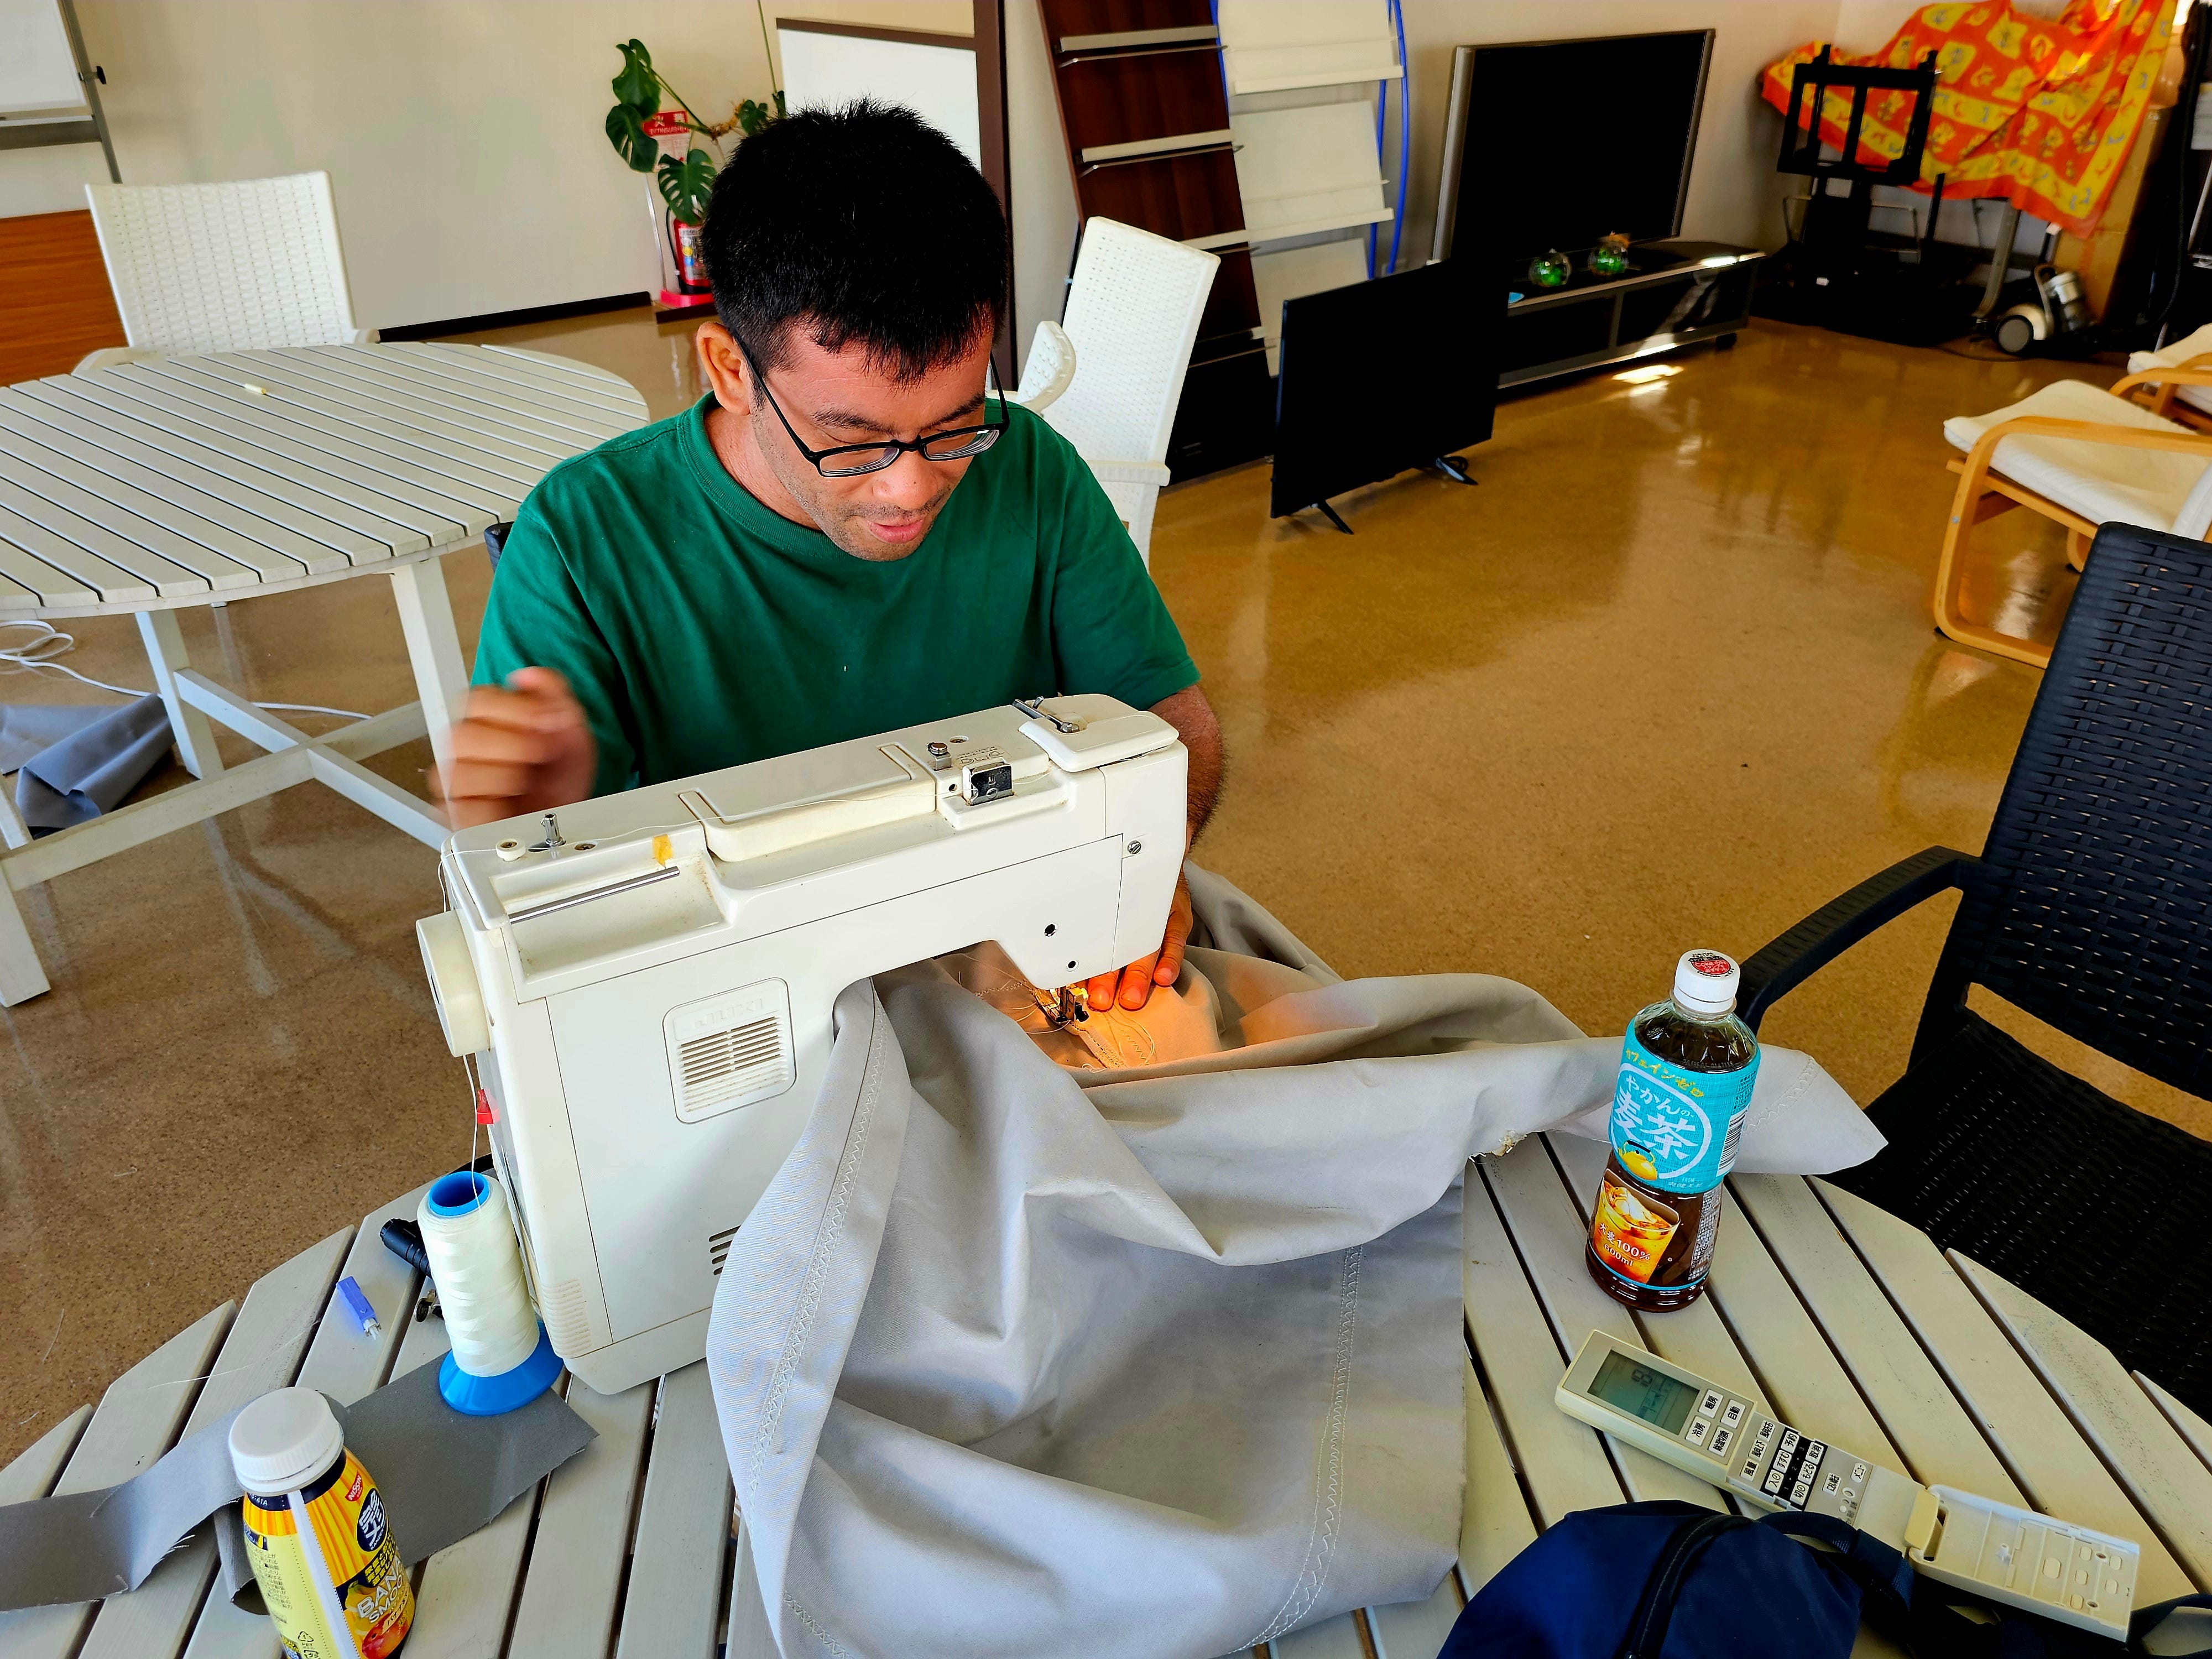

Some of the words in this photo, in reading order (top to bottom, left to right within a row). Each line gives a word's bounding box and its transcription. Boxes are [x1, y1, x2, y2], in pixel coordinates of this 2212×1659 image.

[1625, 1048, 1704, 1098] カフェインゼロ
[1626, 1073, 1694, 1118] やかんの
[1613, 1086, 1699, 1160] 麦茶
[1604, 1244, 1634, 1266] 600ml
[1704, 1395, 1718, 1410] 暖房
[1728, 1406, 1740, 1421] 自動
[1692, 1422, 1705, 1438] 冷房
[1785, 1434, 1797, 1447] 予約
[1809, 1444, 1823, 1459] 取消
[1777, 1452, 1790, 1469] すすむ
[1744, 1461, 1757, 1477] 風量
[1803, 1464, 1815, 1479] もどる
[1854, 1464, 1864, 1480] メニュー
[348, 1475, 362, 1501] NISSIN
